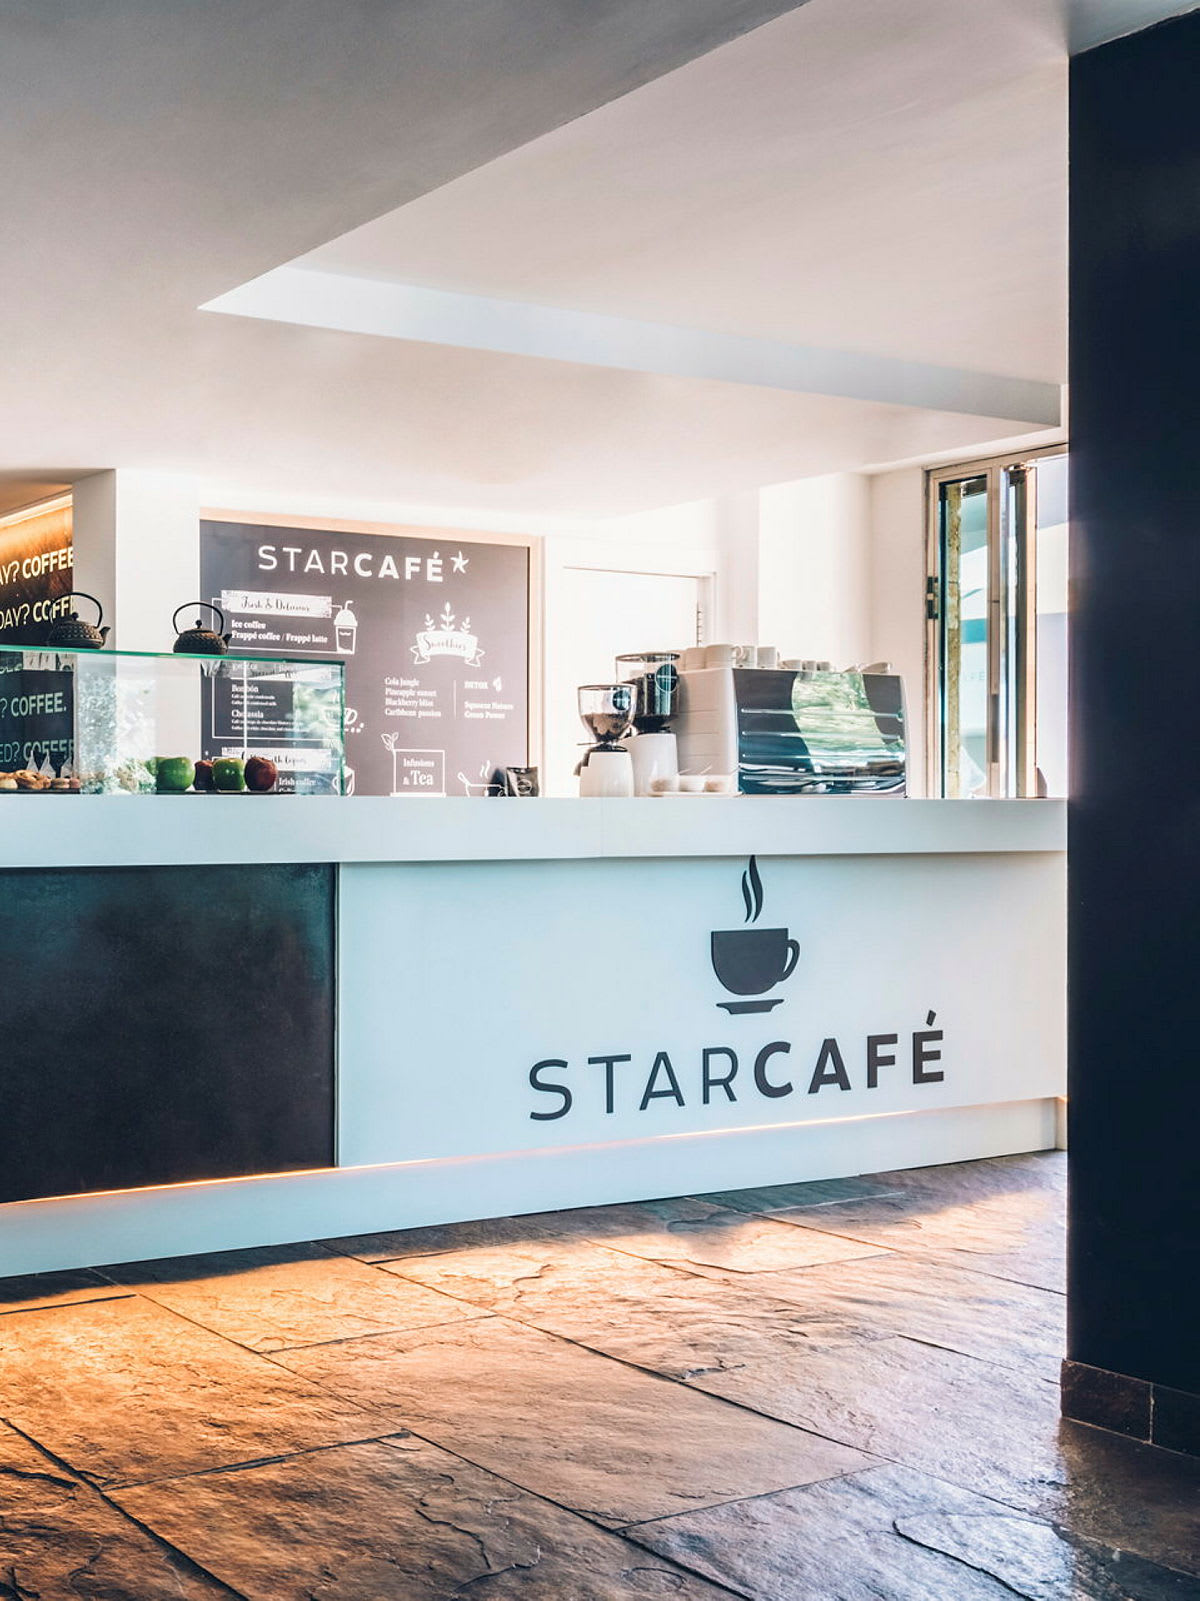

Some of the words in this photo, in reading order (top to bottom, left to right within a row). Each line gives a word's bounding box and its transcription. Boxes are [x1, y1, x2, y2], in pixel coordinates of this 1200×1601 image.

[258, 545, 444, 583] STARCAFÉ
[33, 595, 74, 622] COFF
[11, 692, 67, 717] COFFEE.
[410, 769, 434, 786] Tea
[529, 1010, 945, 1121] STARCAFÉ
